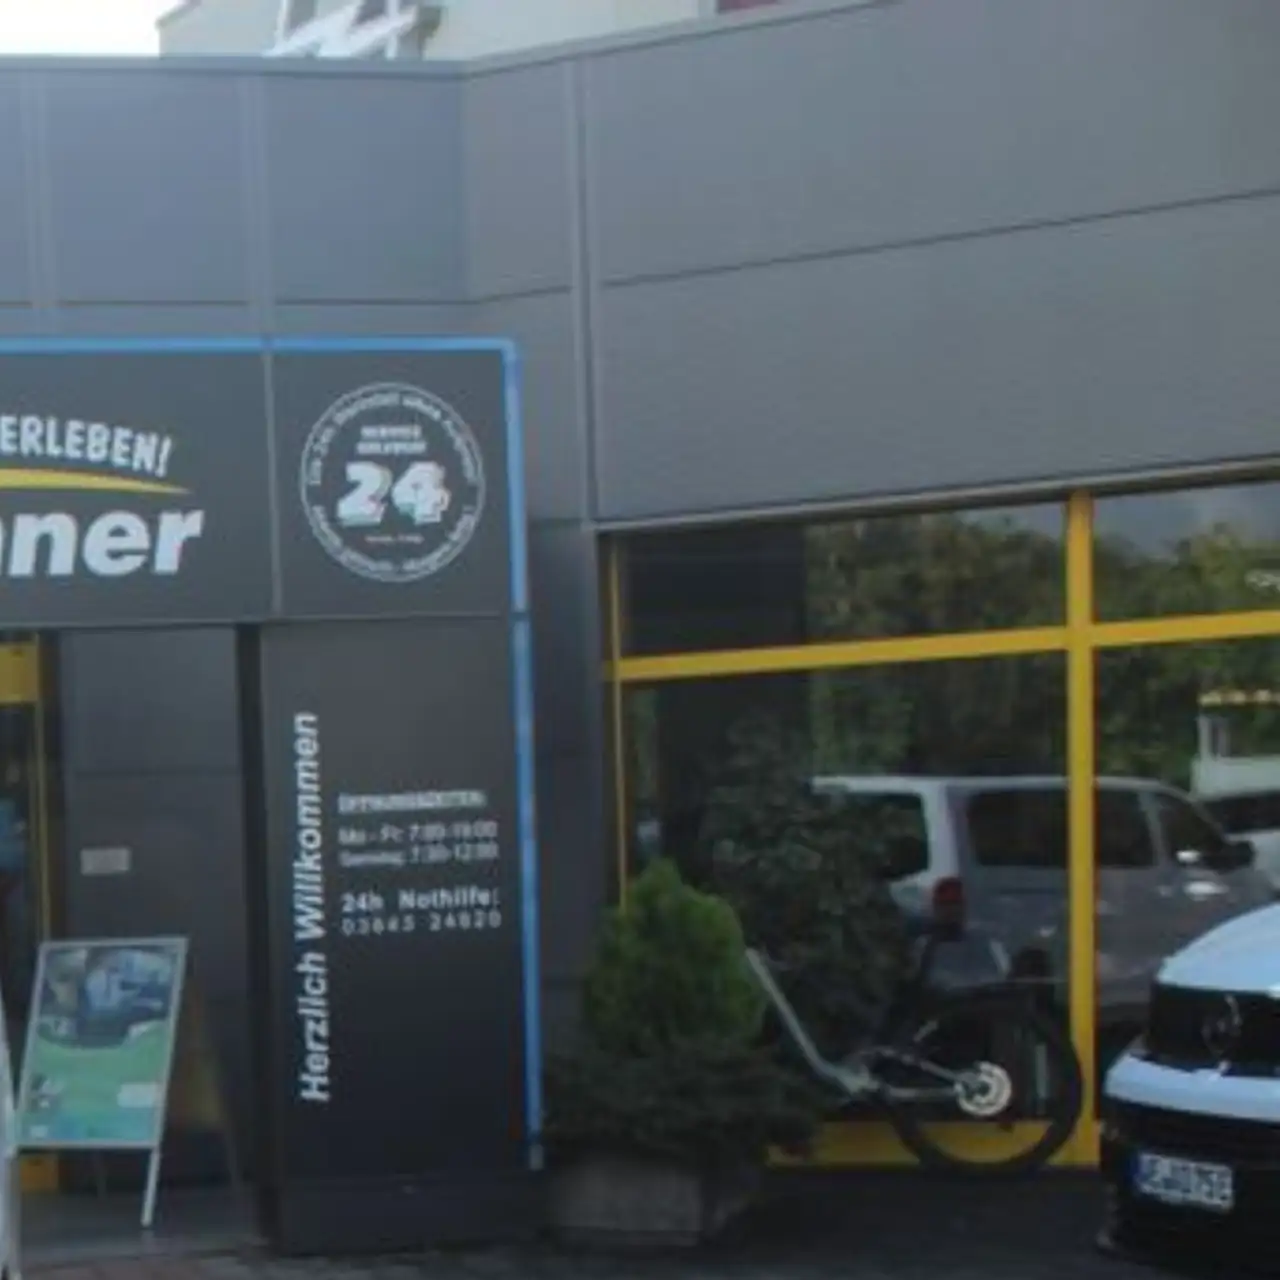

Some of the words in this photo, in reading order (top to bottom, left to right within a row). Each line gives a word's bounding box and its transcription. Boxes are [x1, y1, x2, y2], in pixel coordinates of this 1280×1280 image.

[336, 461, 451, 528] 24
[292, 712, 327, 940] Willkommen
[341, 889, 385, 913] 24h
[295, 951, 331, 1101] Herzlich
